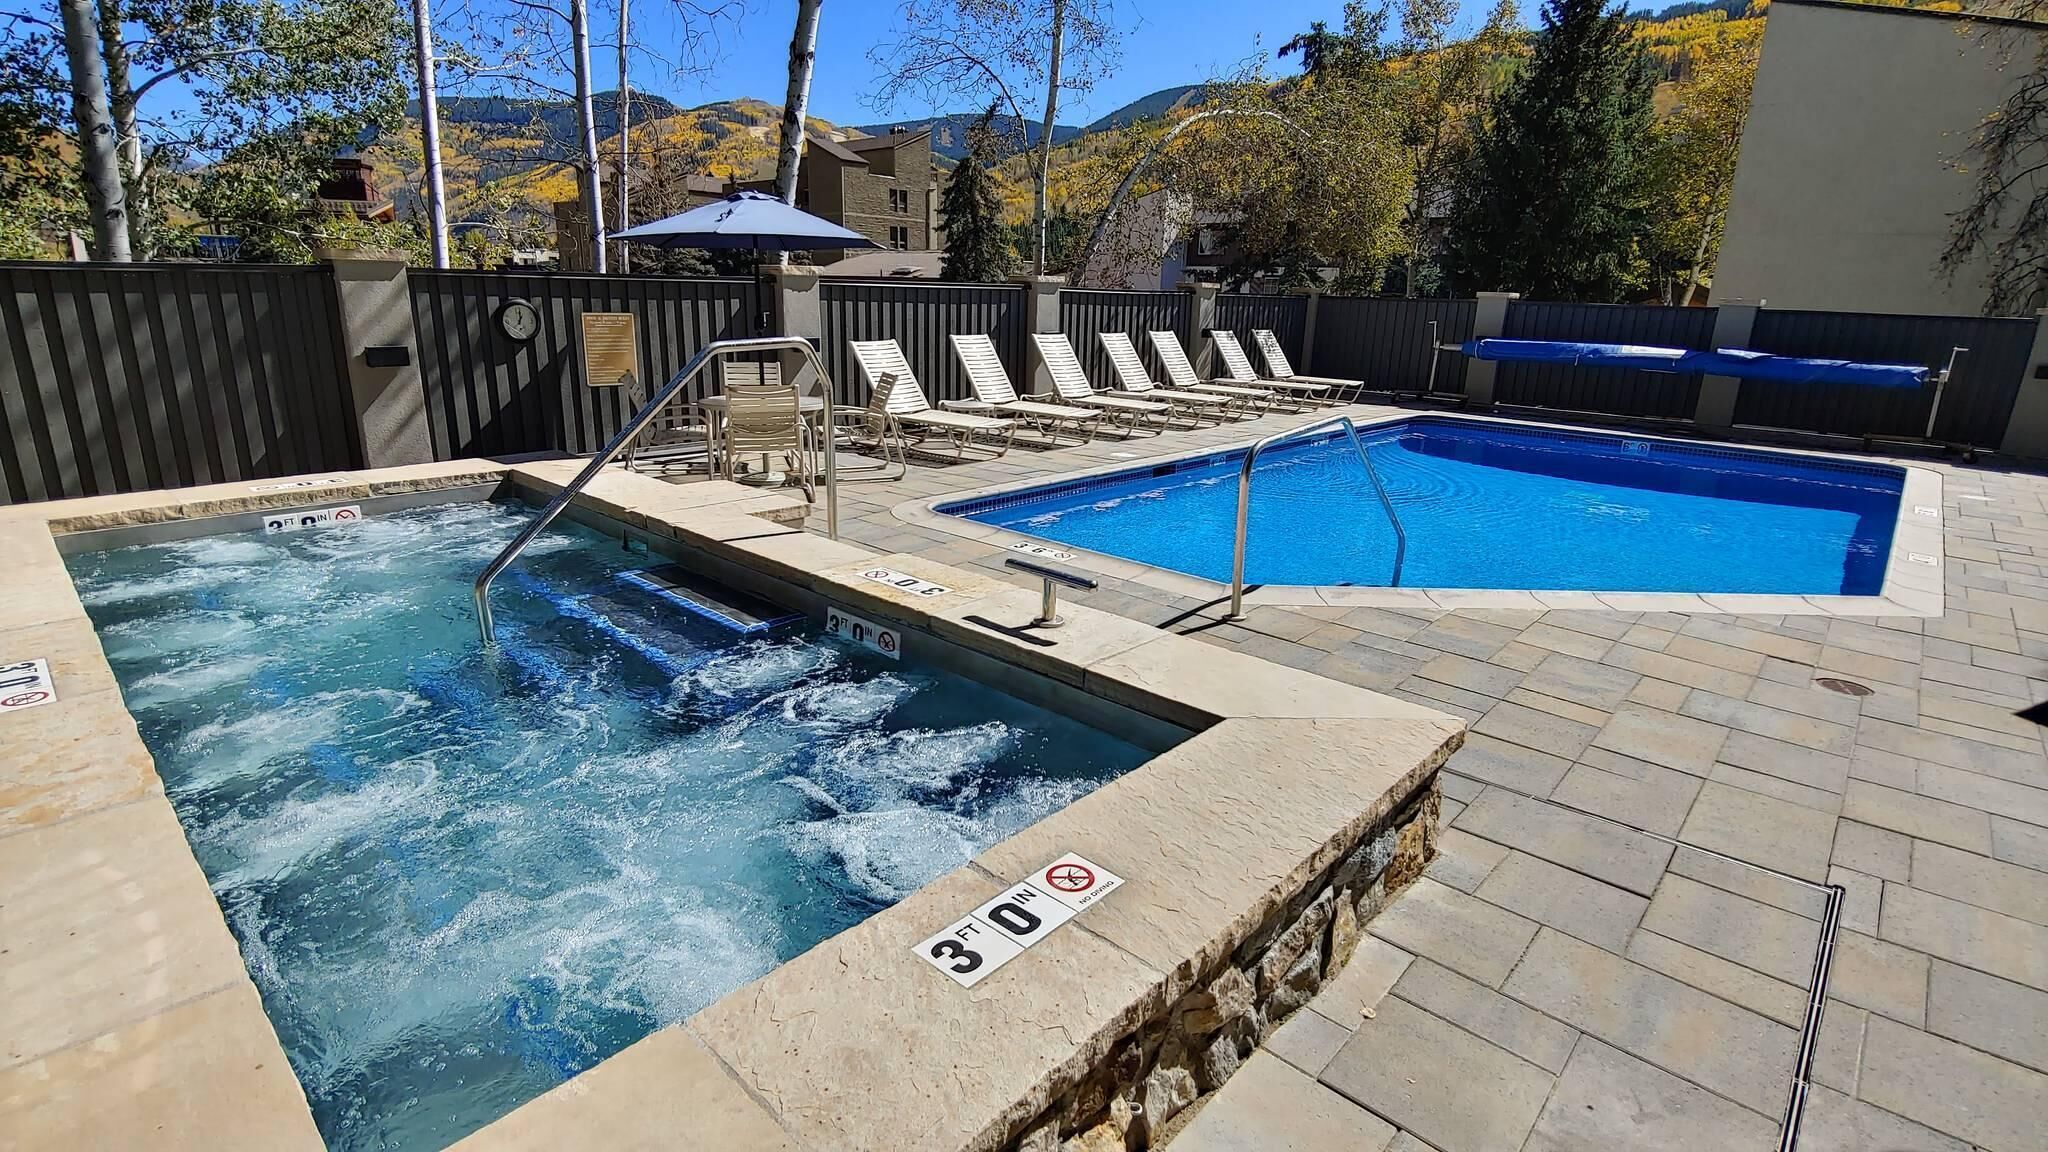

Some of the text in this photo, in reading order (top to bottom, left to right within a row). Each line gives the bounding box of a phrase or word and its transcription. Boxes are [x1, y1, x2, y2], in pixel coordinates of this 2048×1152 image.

[284, 518, 294, 526] FT
[317, 514, 328, 522] IN
[894, 579, 920, 587] 0
[920, 587, 945, 595] 3
[829, 614, 840, 632] 3
[841, 617, 849, 629] FT
[865, 626, 873, 637] IN
[1079, 880, 1115, 905] NO DIVING
[931, 888, 1042, 973] 3 FT 0 IN
